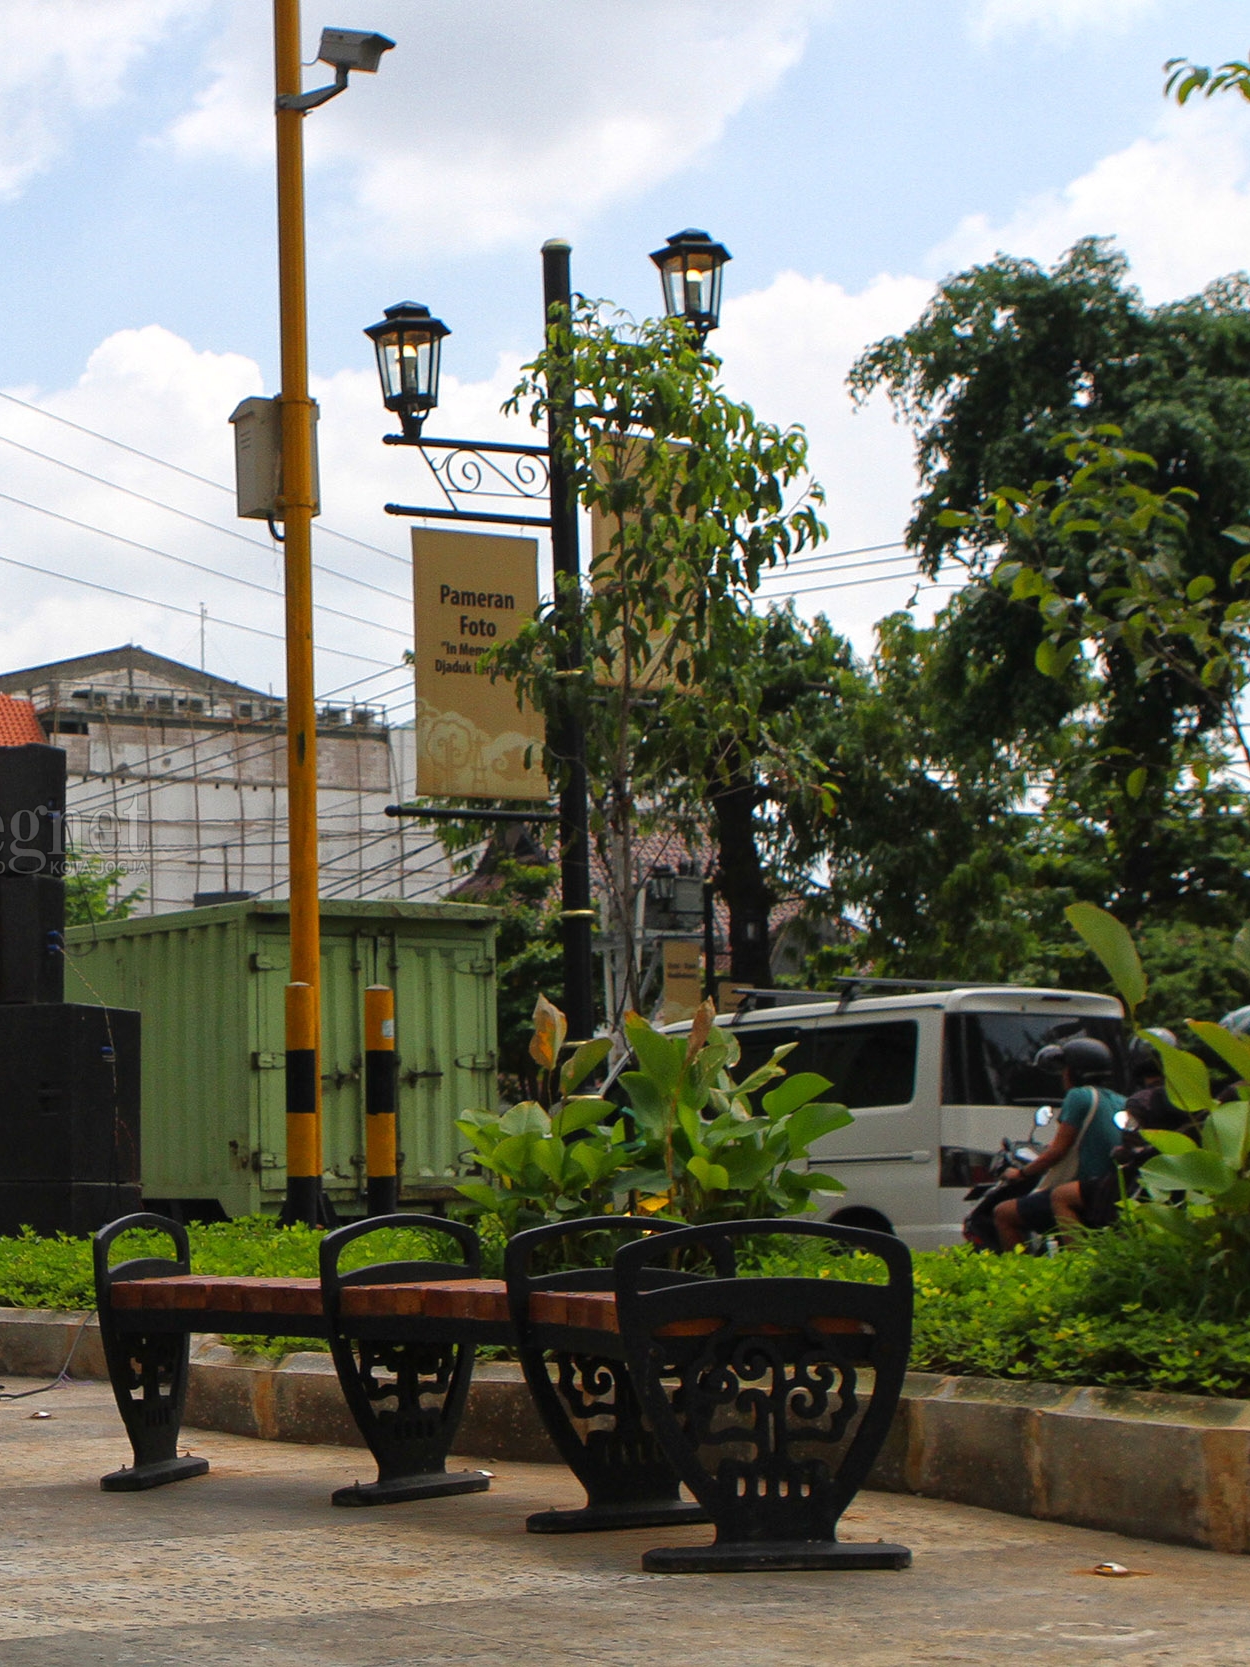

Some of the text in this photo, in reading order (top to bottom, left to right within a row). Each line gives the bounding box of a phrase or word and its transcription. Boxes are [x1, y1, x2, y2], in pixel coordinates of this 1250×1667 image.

[440, 584, 515, 609] Pameran
[459, 615, 497, 637] Foto
[434, 659, 472, 675] Djaduk
